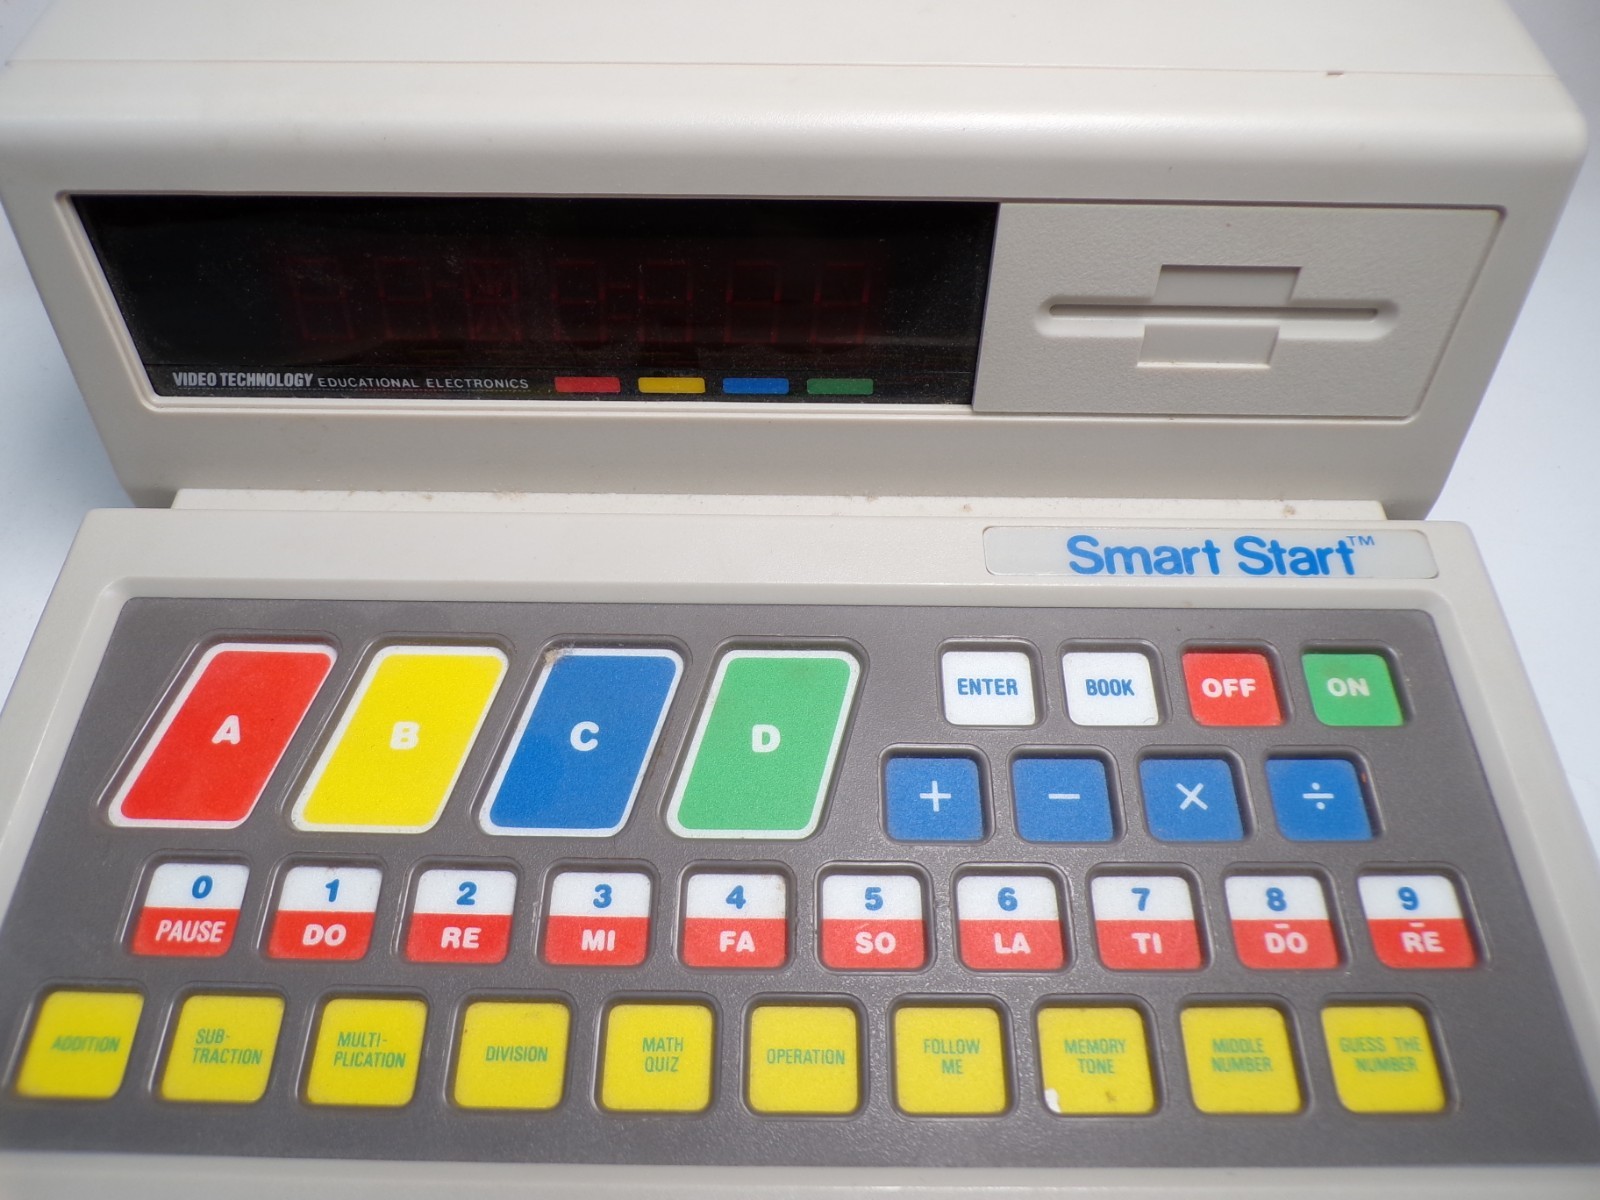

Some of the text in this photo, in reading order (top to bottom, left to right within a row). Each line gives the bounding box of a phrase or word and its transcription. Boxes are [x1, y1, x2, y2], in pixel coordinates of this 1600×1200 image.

[172, 372, 529, 389] VIDEO TECHNOLOGY EDUCATIONAL ELECTRONICS
[1066, 535, 1221, 575] Smart
[1233, 535, 1355, 575] Start
[957, 678, 1018, 696] ENTER
[1085, 679, 1134, 696] BOOK
[1201, 678, 1256, 697] OFF
[1327, 678, 1370, 696] ON
[211, 716, 241, 744] A
[390, 722, 419, 750] B
[570, 722, 599, 751] C
[751, 724, 781, 753] D
[191, 875, 213, 898] 0
[325, 879, 340, 902] 1
[456, 881, 477, 905] 2
[593, 884, 612, 908] 3
[725, 885, 747, 909] 4
[864, 887, 883, 910] 5
[998, 887, 1018, 911] 6
[1131, 887, 1151, 910] 7
[1266, 887, 1287, 911] 8
[1398, 886, 1418, 910] 9
[155, 920, 226, 942] PAUSE
[303, 924, 346, 946] DO
[441, 927, 482, 948] RE
[581, 930, 615, 951] MI
[719, 931, 755, 953] FA
[855, 931, 896, 954] SO
[994, 933, 1031, 954] LA
[1132, 932, 1162, 954] TI
[51, 1035, 120, 1053] ADDITION
[195, 1028, 231, 1044] SUB-
[338, 1031, 387, 1047] MULTI-
[642, 1036, 684, 1053] MATH
[923, 1038, 980, 1055] FOLLOW
[1064, 1037, 1126, 1054] MEMORY
[1212, 1037, 1265, 1054] MIDDLE
[1339, 1036, 1424, 1053] GUESS THE
[192, 1047, 262, 1065] TRACTION
[333, 1050, 405, 1068] PLICATION
[485, 1044, 548, 1061] DIVISION
[766, 1048, 845, 1065] OPERATION
[644, 1056, 679, 1073] QUIZ
[941, 1059, 963, 1075] ME
[1077, 1058, 1115, 1074] TONE
[1211, 1056, 1272, 1073] NUMBER
[1355, 1056, 1418, 1073] NUMBER
